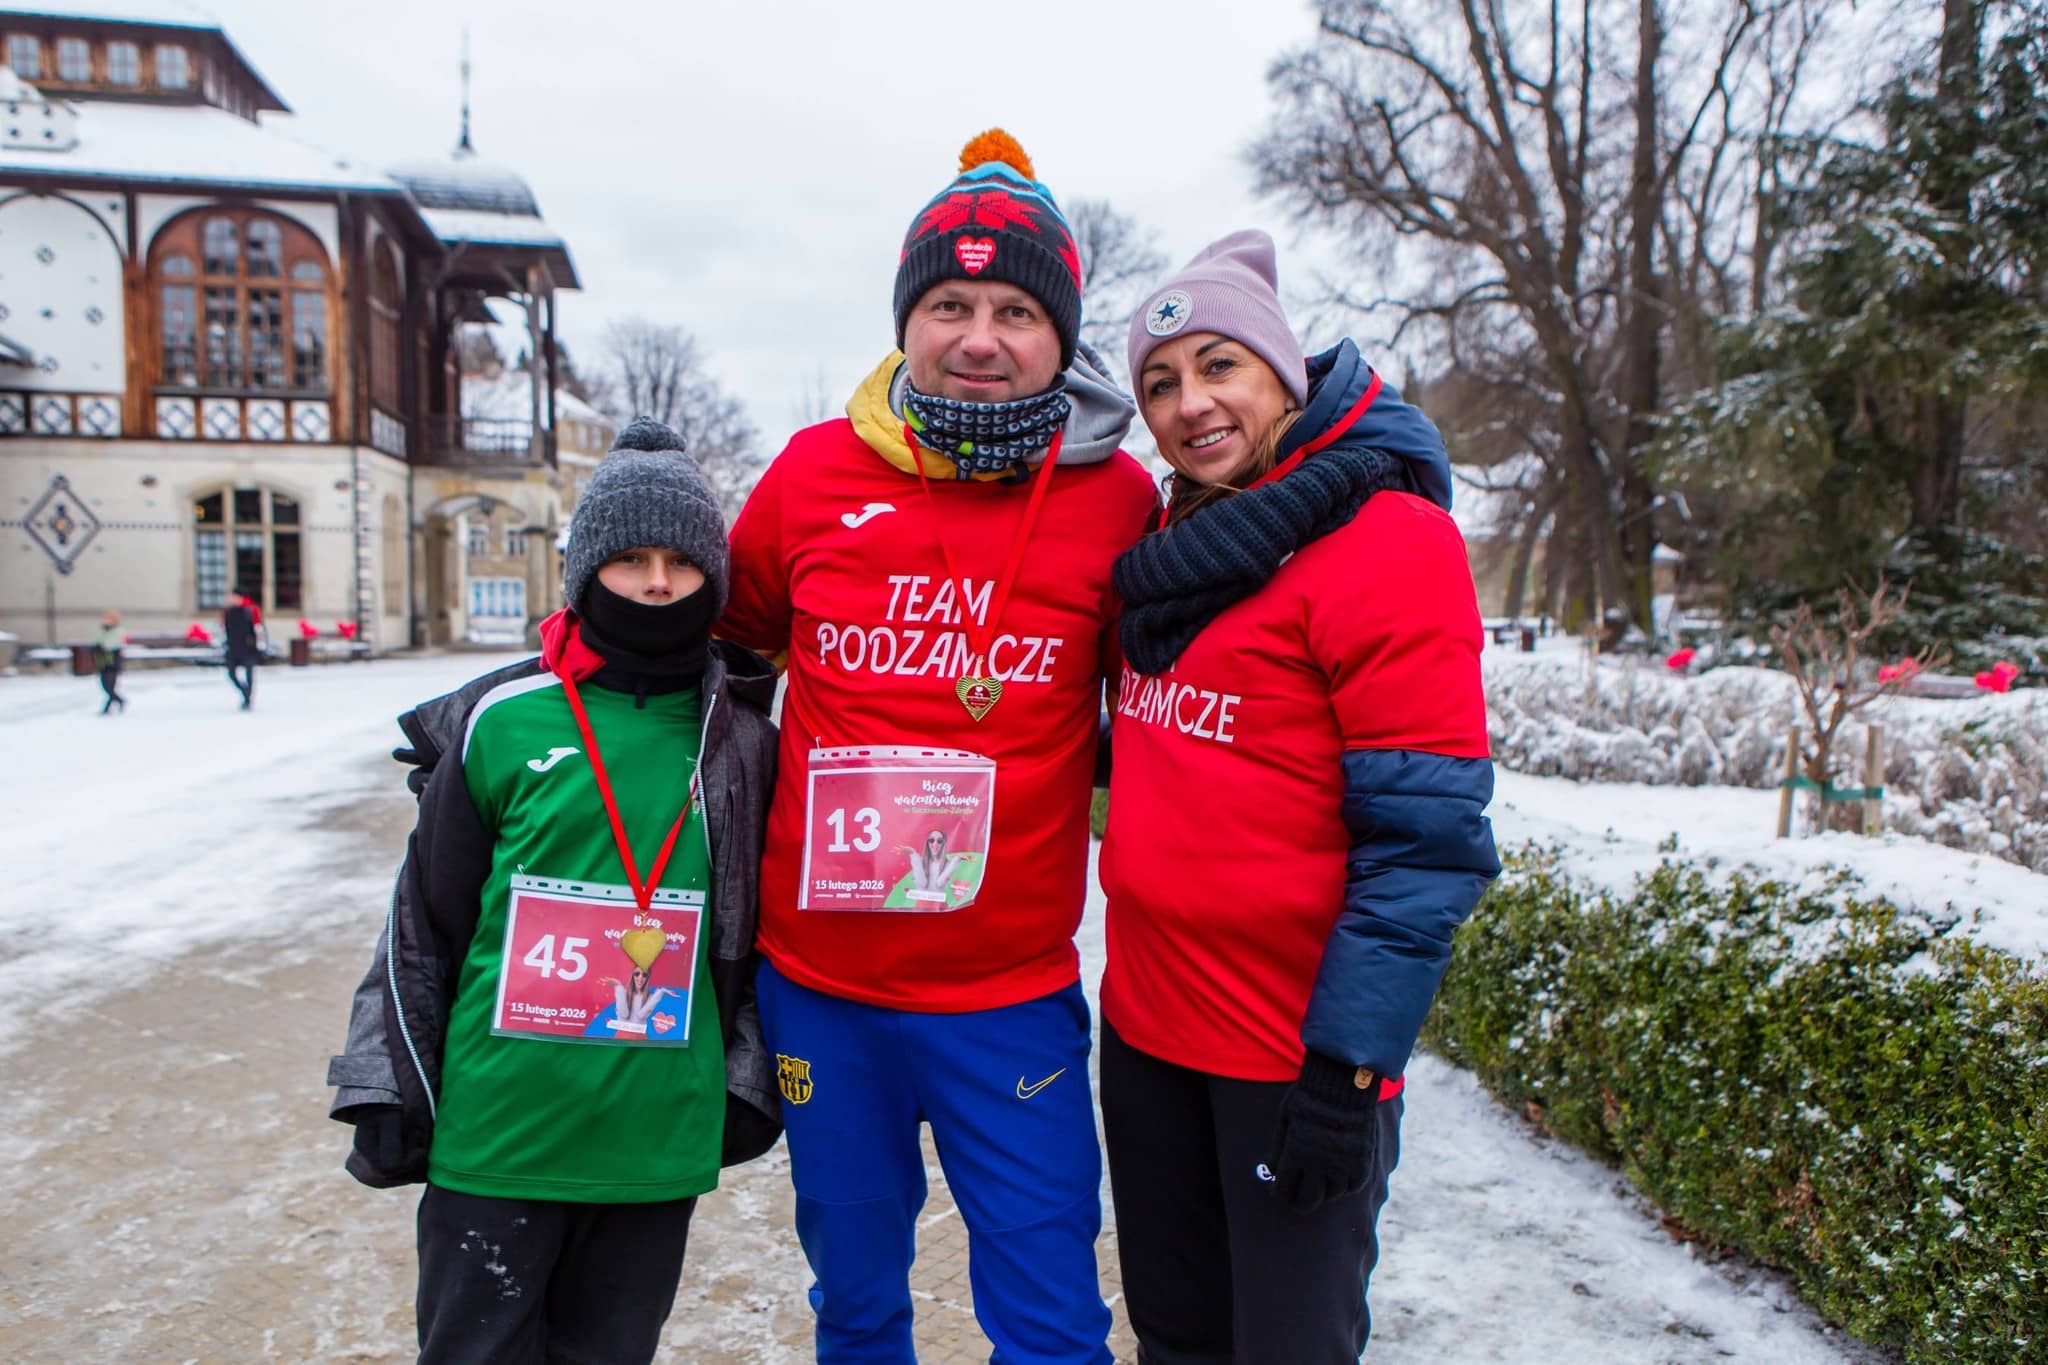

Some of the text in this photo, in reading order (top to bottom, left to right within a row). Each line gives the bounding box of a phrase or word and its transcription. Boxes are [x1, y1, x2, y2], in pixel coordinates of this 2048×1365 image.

[886, 574, 996, 627] TEAM
[816, 621, 1064, 684] PODZAMCZE
[1117, 667, 1241, 743] DZAMCZE
[826, 806, 881, 853] 13
[815, 880, 885, 892] 15 lutego 2026
[523, 934, 590, 981] 45
[511, 1002, 587, 1019] 15 lutego 2026
